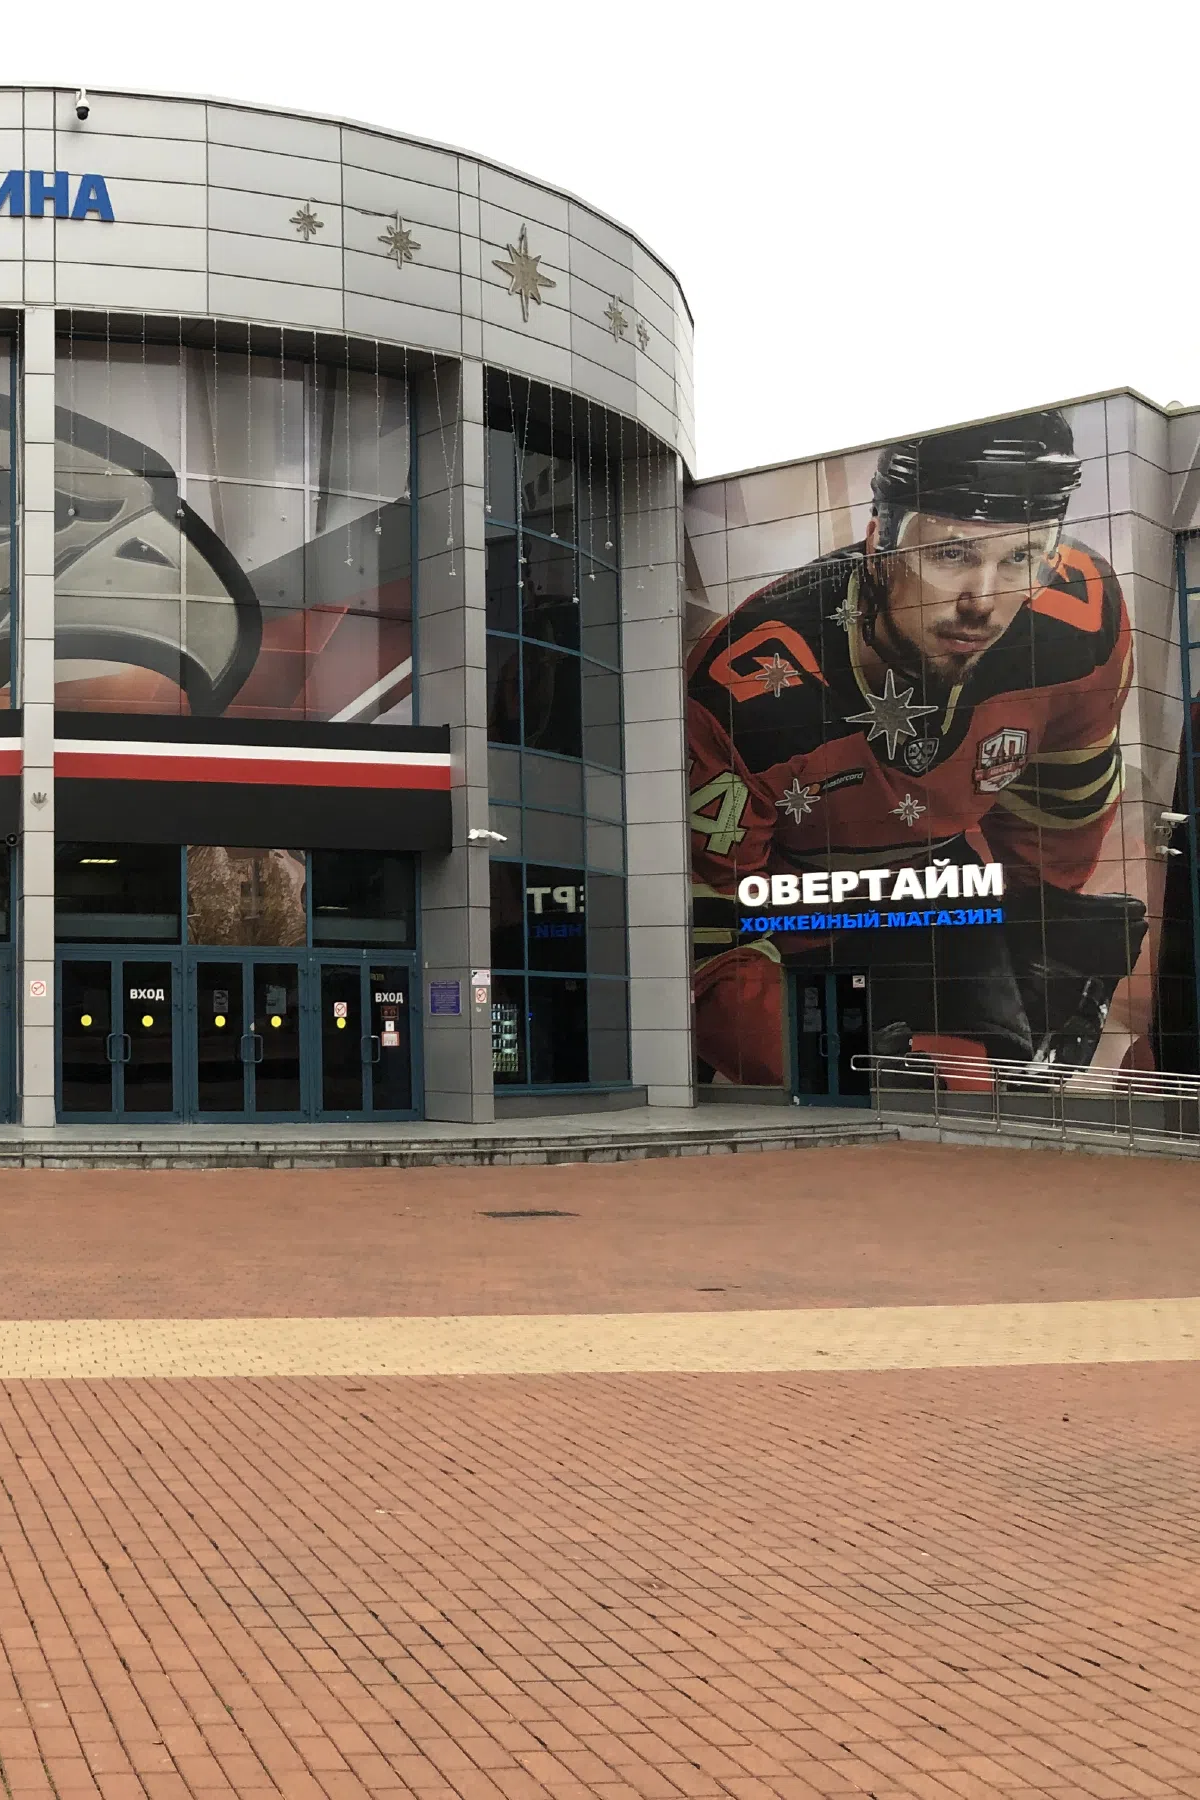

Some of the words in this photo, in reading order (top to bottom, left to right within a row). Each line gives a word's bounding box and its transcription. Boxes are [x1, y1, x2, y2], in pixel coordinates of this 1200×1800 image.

[738, 859, 1004, 907] ОВЕРТАЙМ
[740, 909, 881, 933] ХОККЕЙНЫЙ
[887, 907, 1005, 929] МАГАЗИН
[129, 988, 165, 1001] ВХОД
[375, 992, 404, 1004] ВХОД
